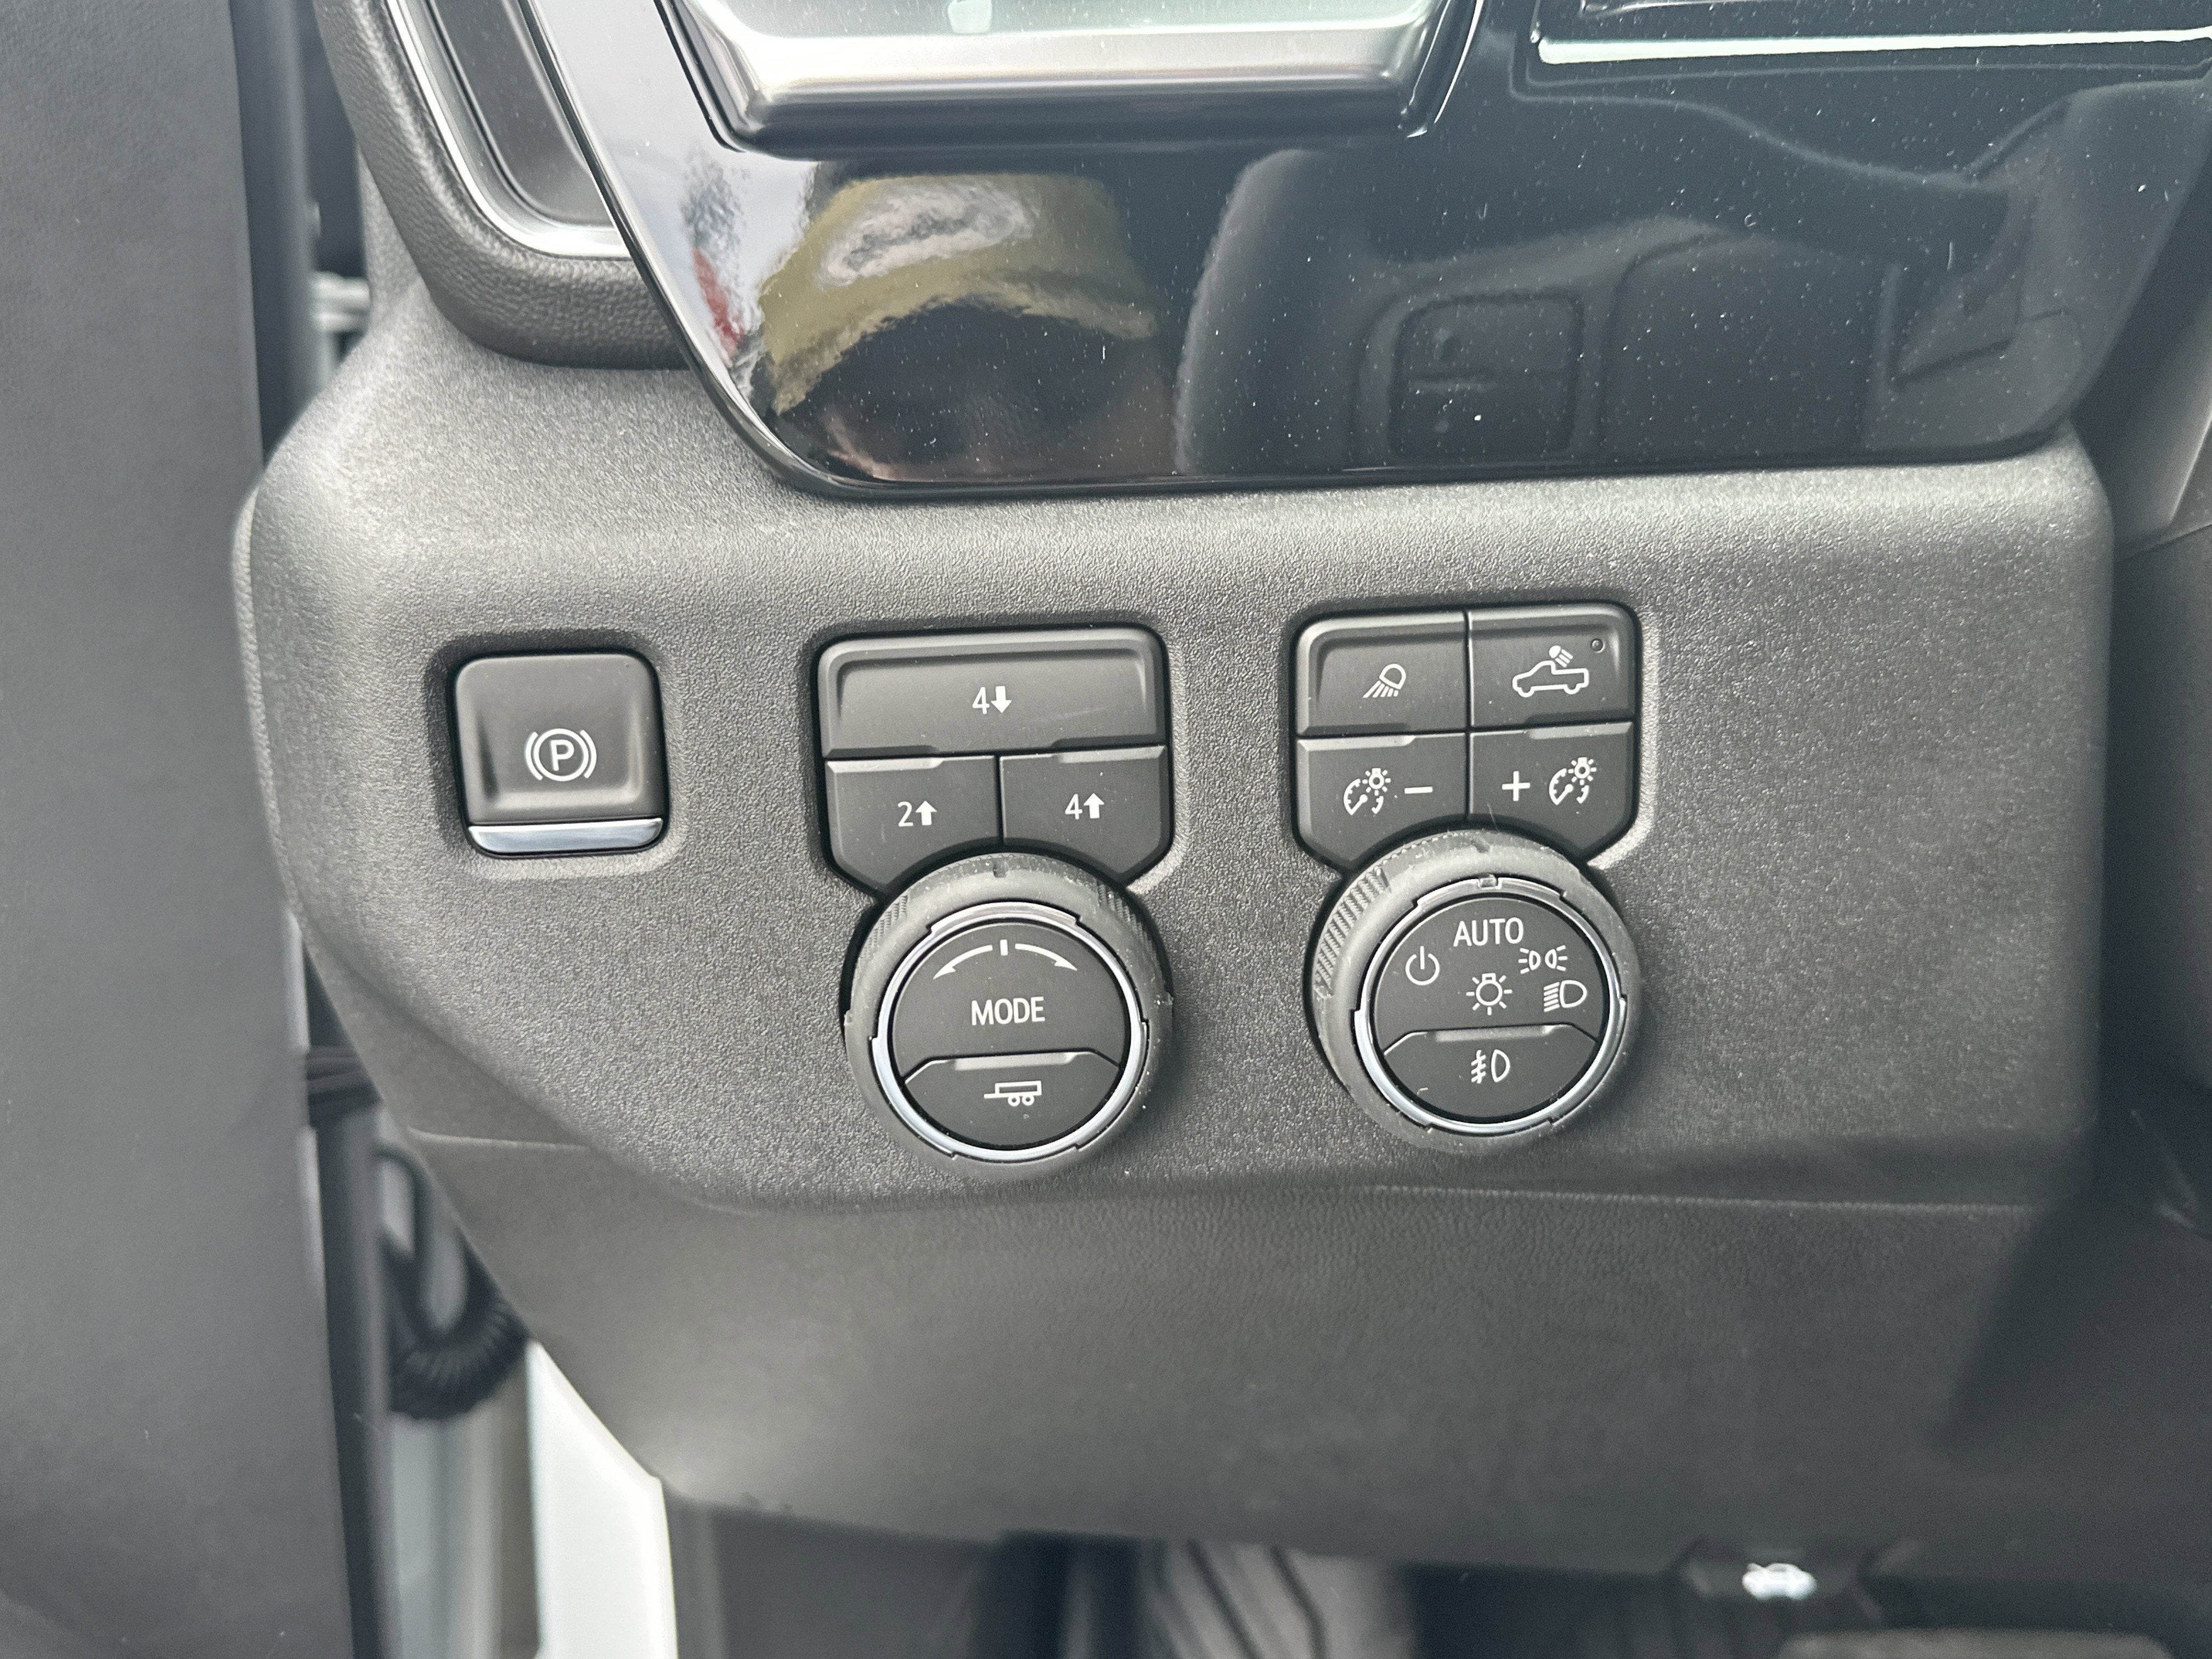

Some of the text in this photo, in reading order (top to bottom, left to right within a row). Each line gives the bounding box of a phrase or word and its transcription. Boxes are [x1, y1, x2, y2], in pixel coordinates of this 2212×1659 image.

[550, 739, 575, 771] P
[1453, 917, 1524, 947] AUTO
[971, 996, 1046, 1025] MODE
